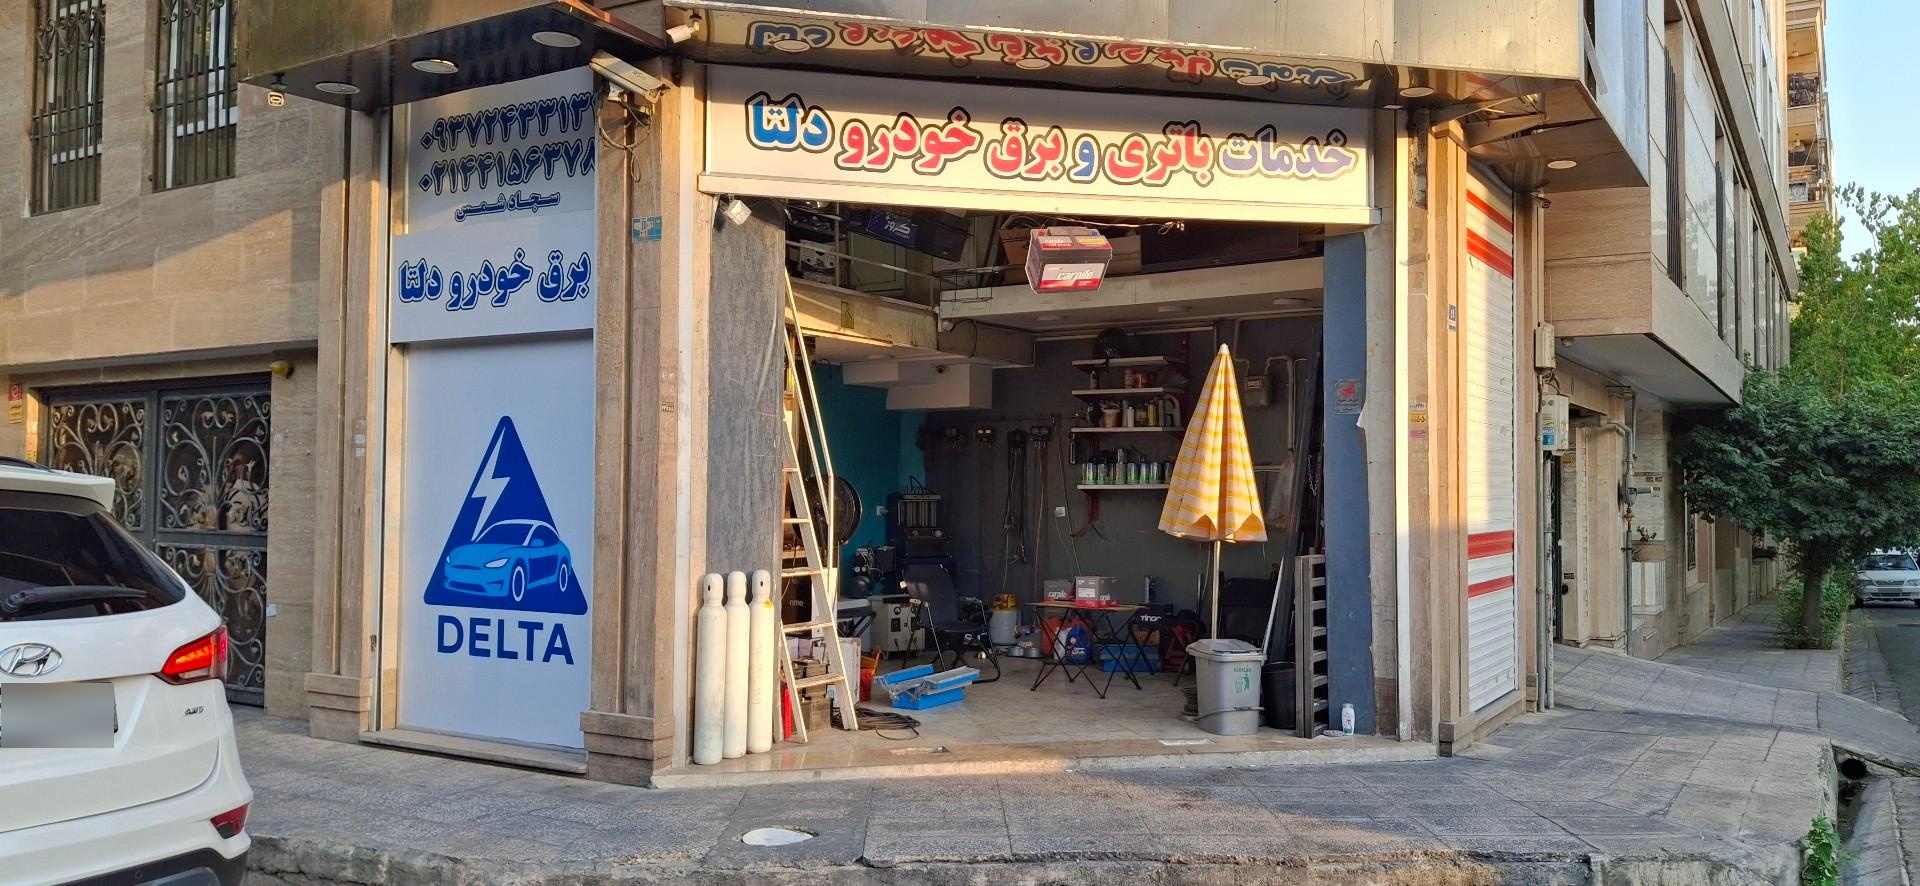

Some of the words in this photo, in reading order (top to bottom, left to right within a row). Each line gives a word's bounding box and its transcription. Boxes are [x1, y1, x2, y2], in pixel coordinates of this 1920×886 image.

[421, 92, 597, 152] ۰۹۳۷۲۴۳۳۱۳
[746, 91, 835, 153] دلتا
[834, 106, 983, 175] خودرو
[984, 117, 1068, 181] برق
[1067, 133, 1100, 184] و
[1103, 120, 1214, 187] باتری
[1218, 125, 1358, 180] خدمات
[455, 192, 506, 222] شمس
[507, 190, 560, 213] سجاد
[399, 258, 443, 302] دلتا
[446, 248, 533, 311] خودرو
[537, 250, 591, 302] برق
[437, 614, 574, 665] DELTA
